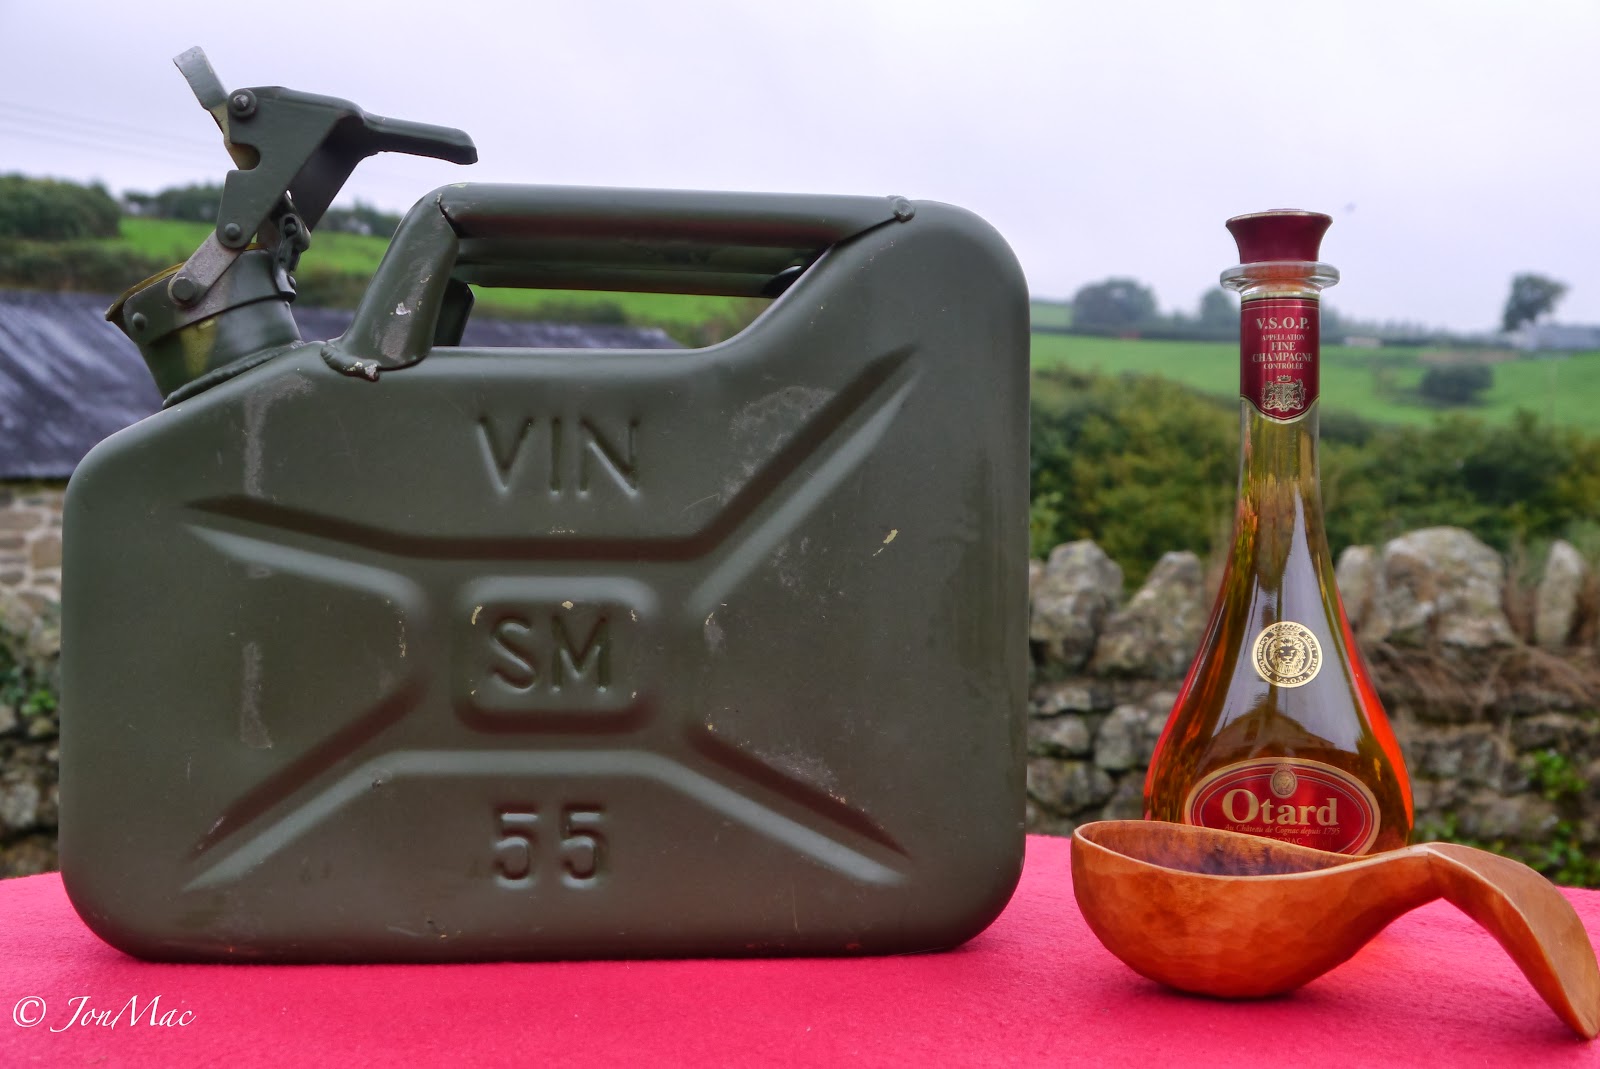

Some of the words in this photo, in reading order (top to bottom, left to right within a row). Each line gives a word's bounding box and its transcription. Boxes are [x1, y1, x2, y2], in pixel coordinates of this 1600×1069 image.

[1256, 316, 1310, 330] V.S.O.P.
[1262, 333, 1305, 341] APPELLATION
[1271, 341, 1296, 351] FINE
[1252, 352, 1313, 363] CHAMPAGNE
[474, 412, 642, 502] VIN
[488, 611, 612, 695] SM
[1221, 788, 1339, 827] Otard
[1265, 826, 1274, 834] de
[1274, 826, 1299, 836] Cognac
[1300, 827, 1321, 836] depuis
[1322, 827, 1341, 835] 1795
